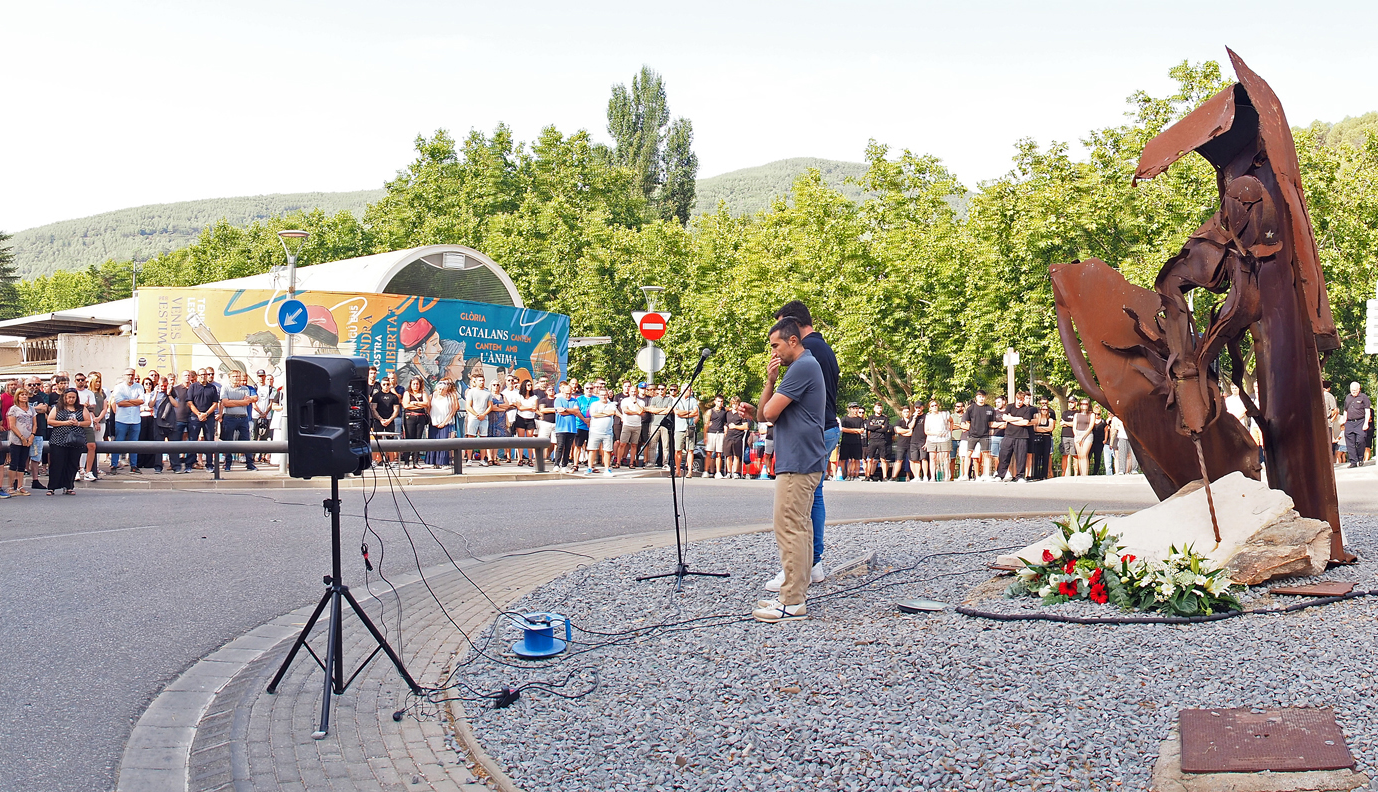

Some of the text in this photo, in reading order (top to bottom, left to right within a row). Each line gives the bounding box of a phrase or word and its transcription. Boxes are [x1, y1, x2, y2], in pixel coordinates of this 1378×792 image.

[171, 296, 182, 340] VENES
[349, 305, 358, 322] ENS
[460, 311, 486, 322] GLÒRIA
[459, 326, 531, 343] CATALANS CANTEM
[475, 342, 518, 353] CANTEM AMB
[480, 351, 517, 365] L'ÀNIMA
